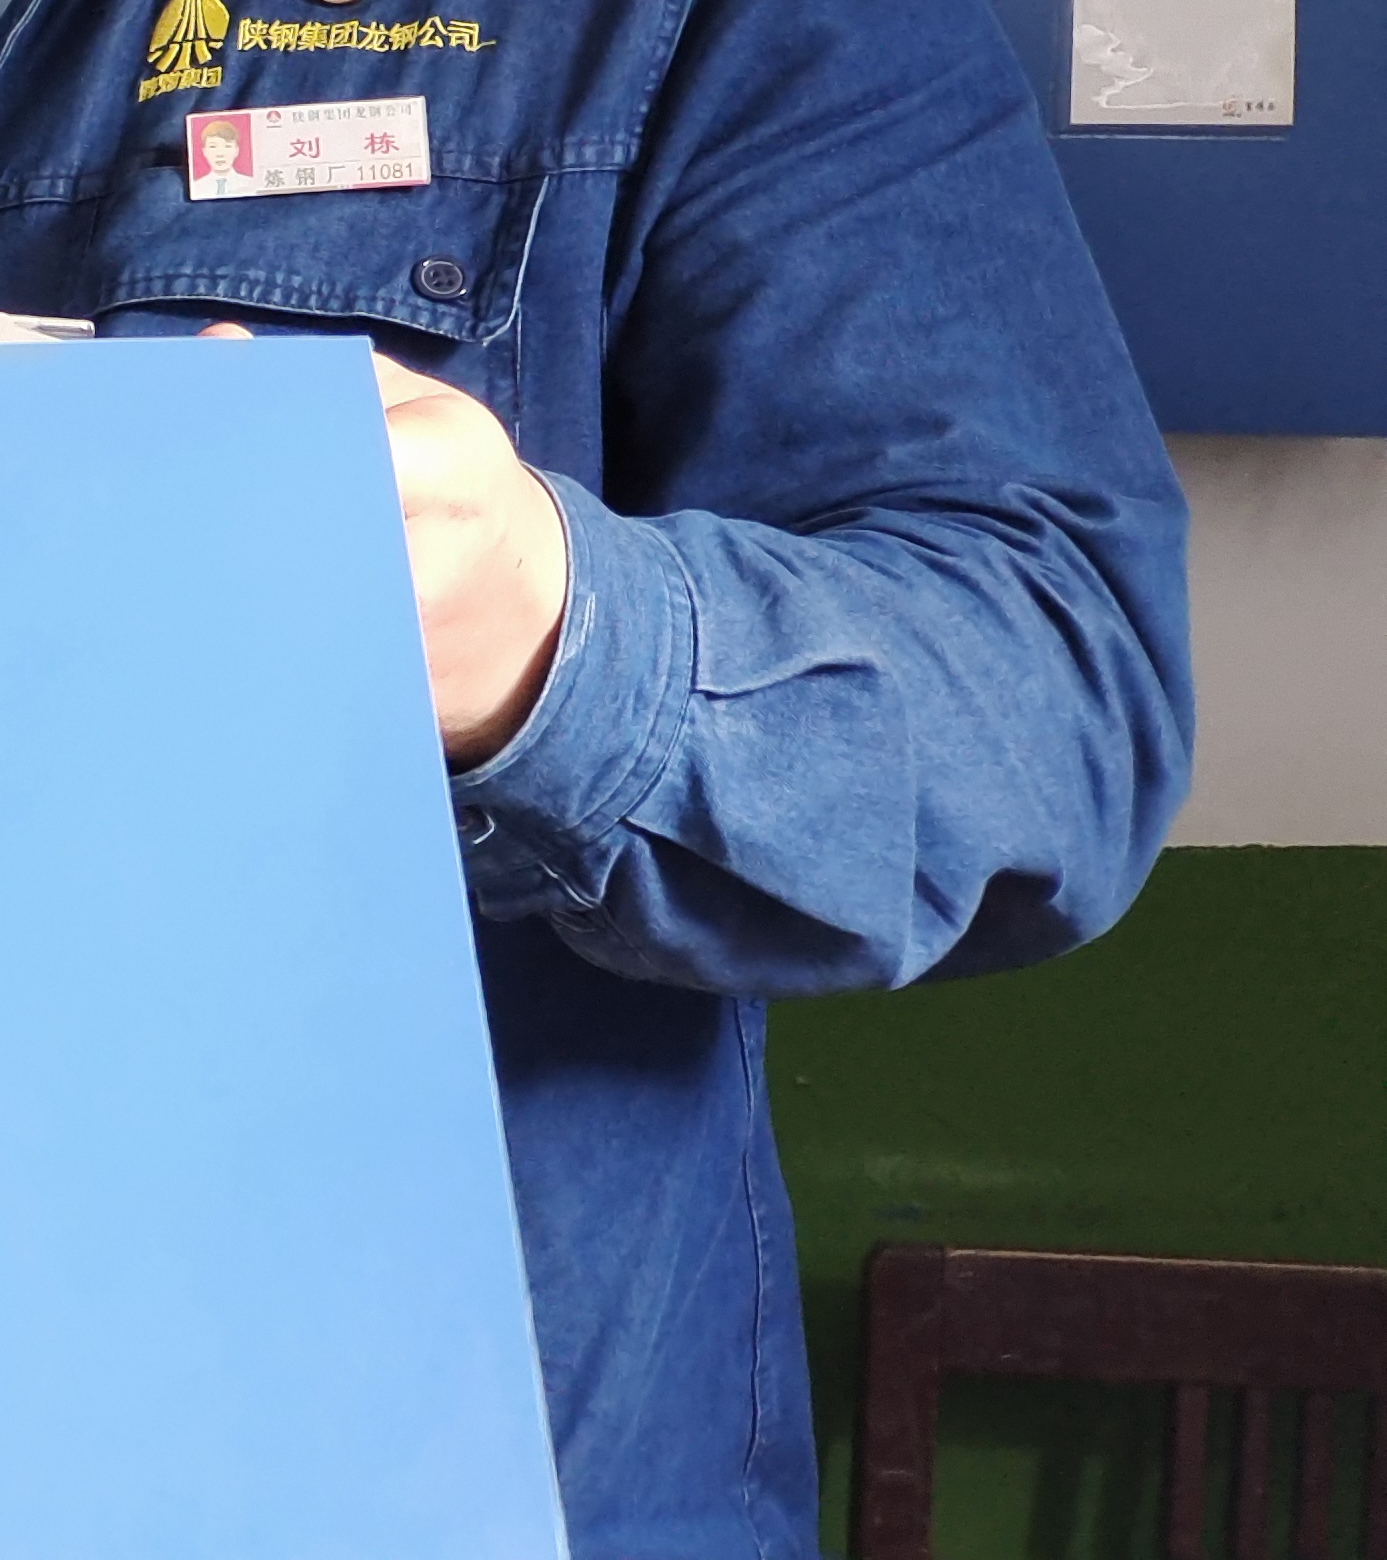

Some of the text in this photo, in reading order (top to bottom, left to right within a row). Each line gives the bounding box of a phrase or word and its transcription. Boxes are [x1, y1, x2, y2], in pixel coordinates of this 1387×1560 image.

[237, 16, 483, 53] 陕钢集团龙钢公司
[263, 162, 414, 188] 炼钢厂 11081
